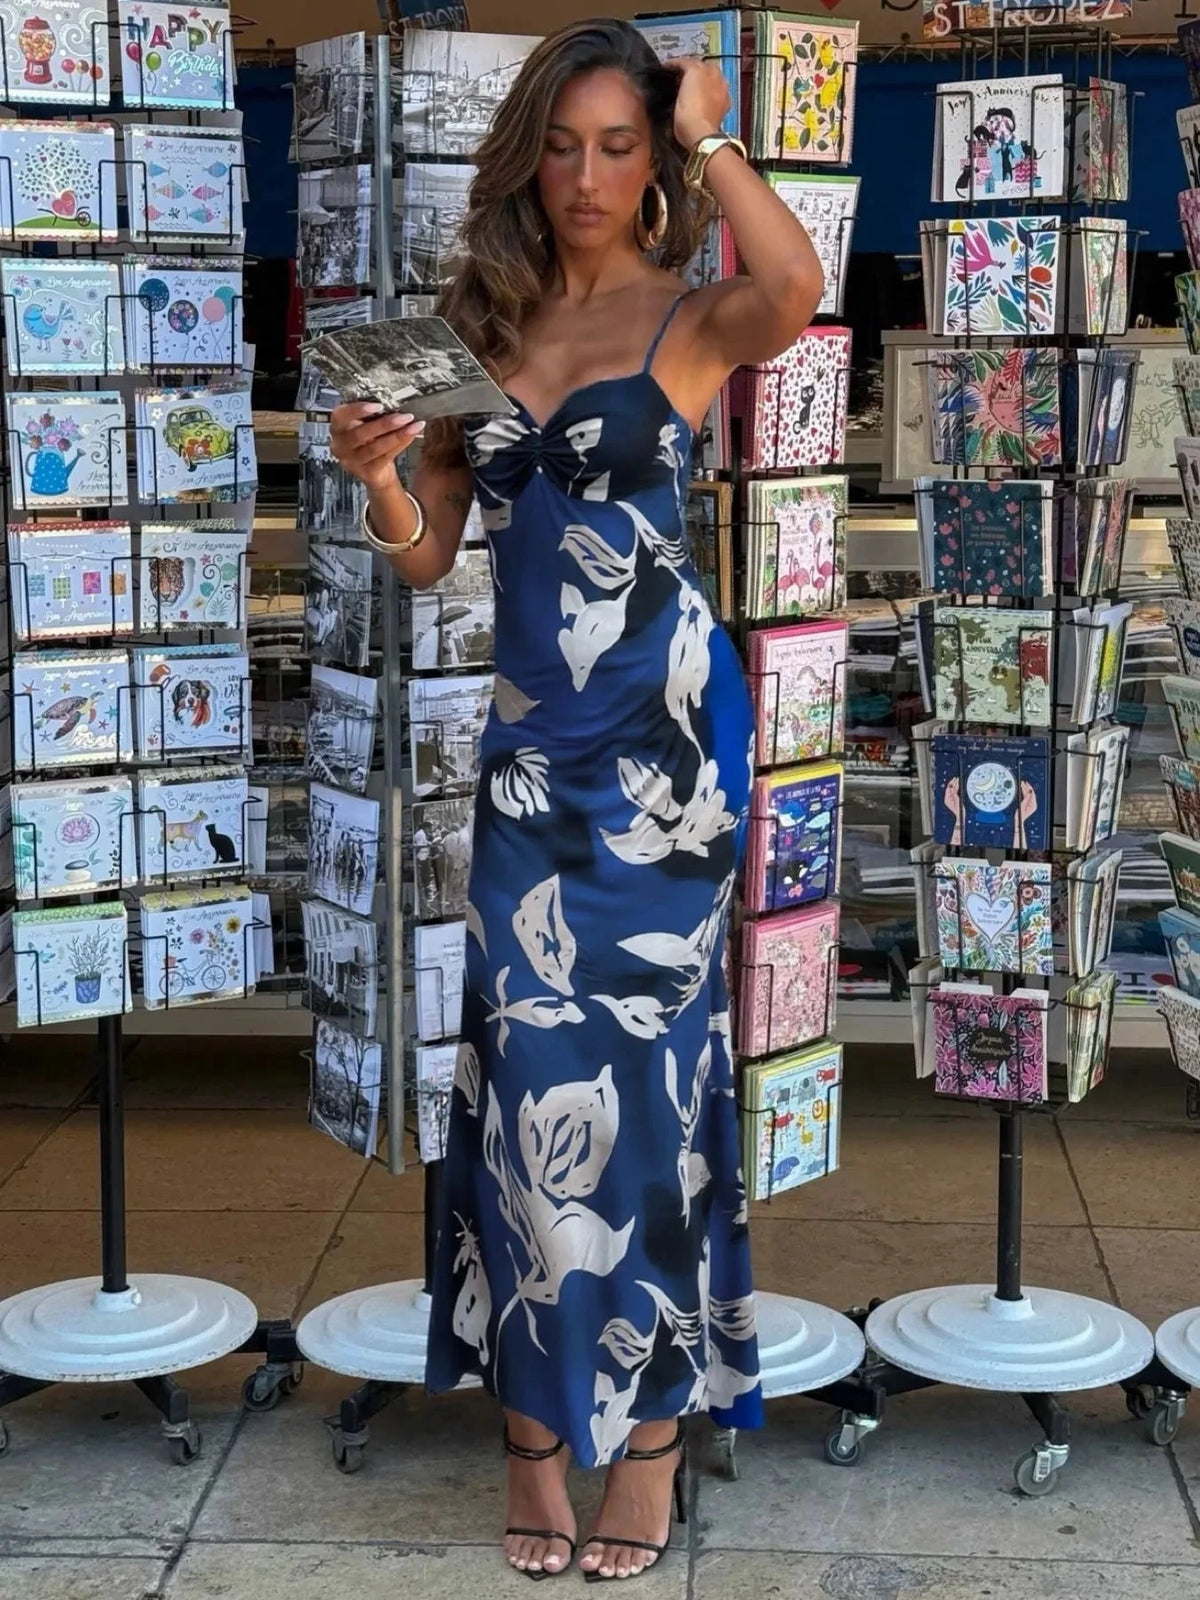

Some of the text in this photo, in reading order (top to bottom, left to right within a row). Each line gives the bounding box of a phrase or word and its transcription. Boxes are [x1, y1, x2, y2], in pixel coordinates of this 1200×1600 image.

[127, 13, 224, 52] HAPPY
[932, 2, 967, 37] ST
[168, 50, 224, 78] Birthday
